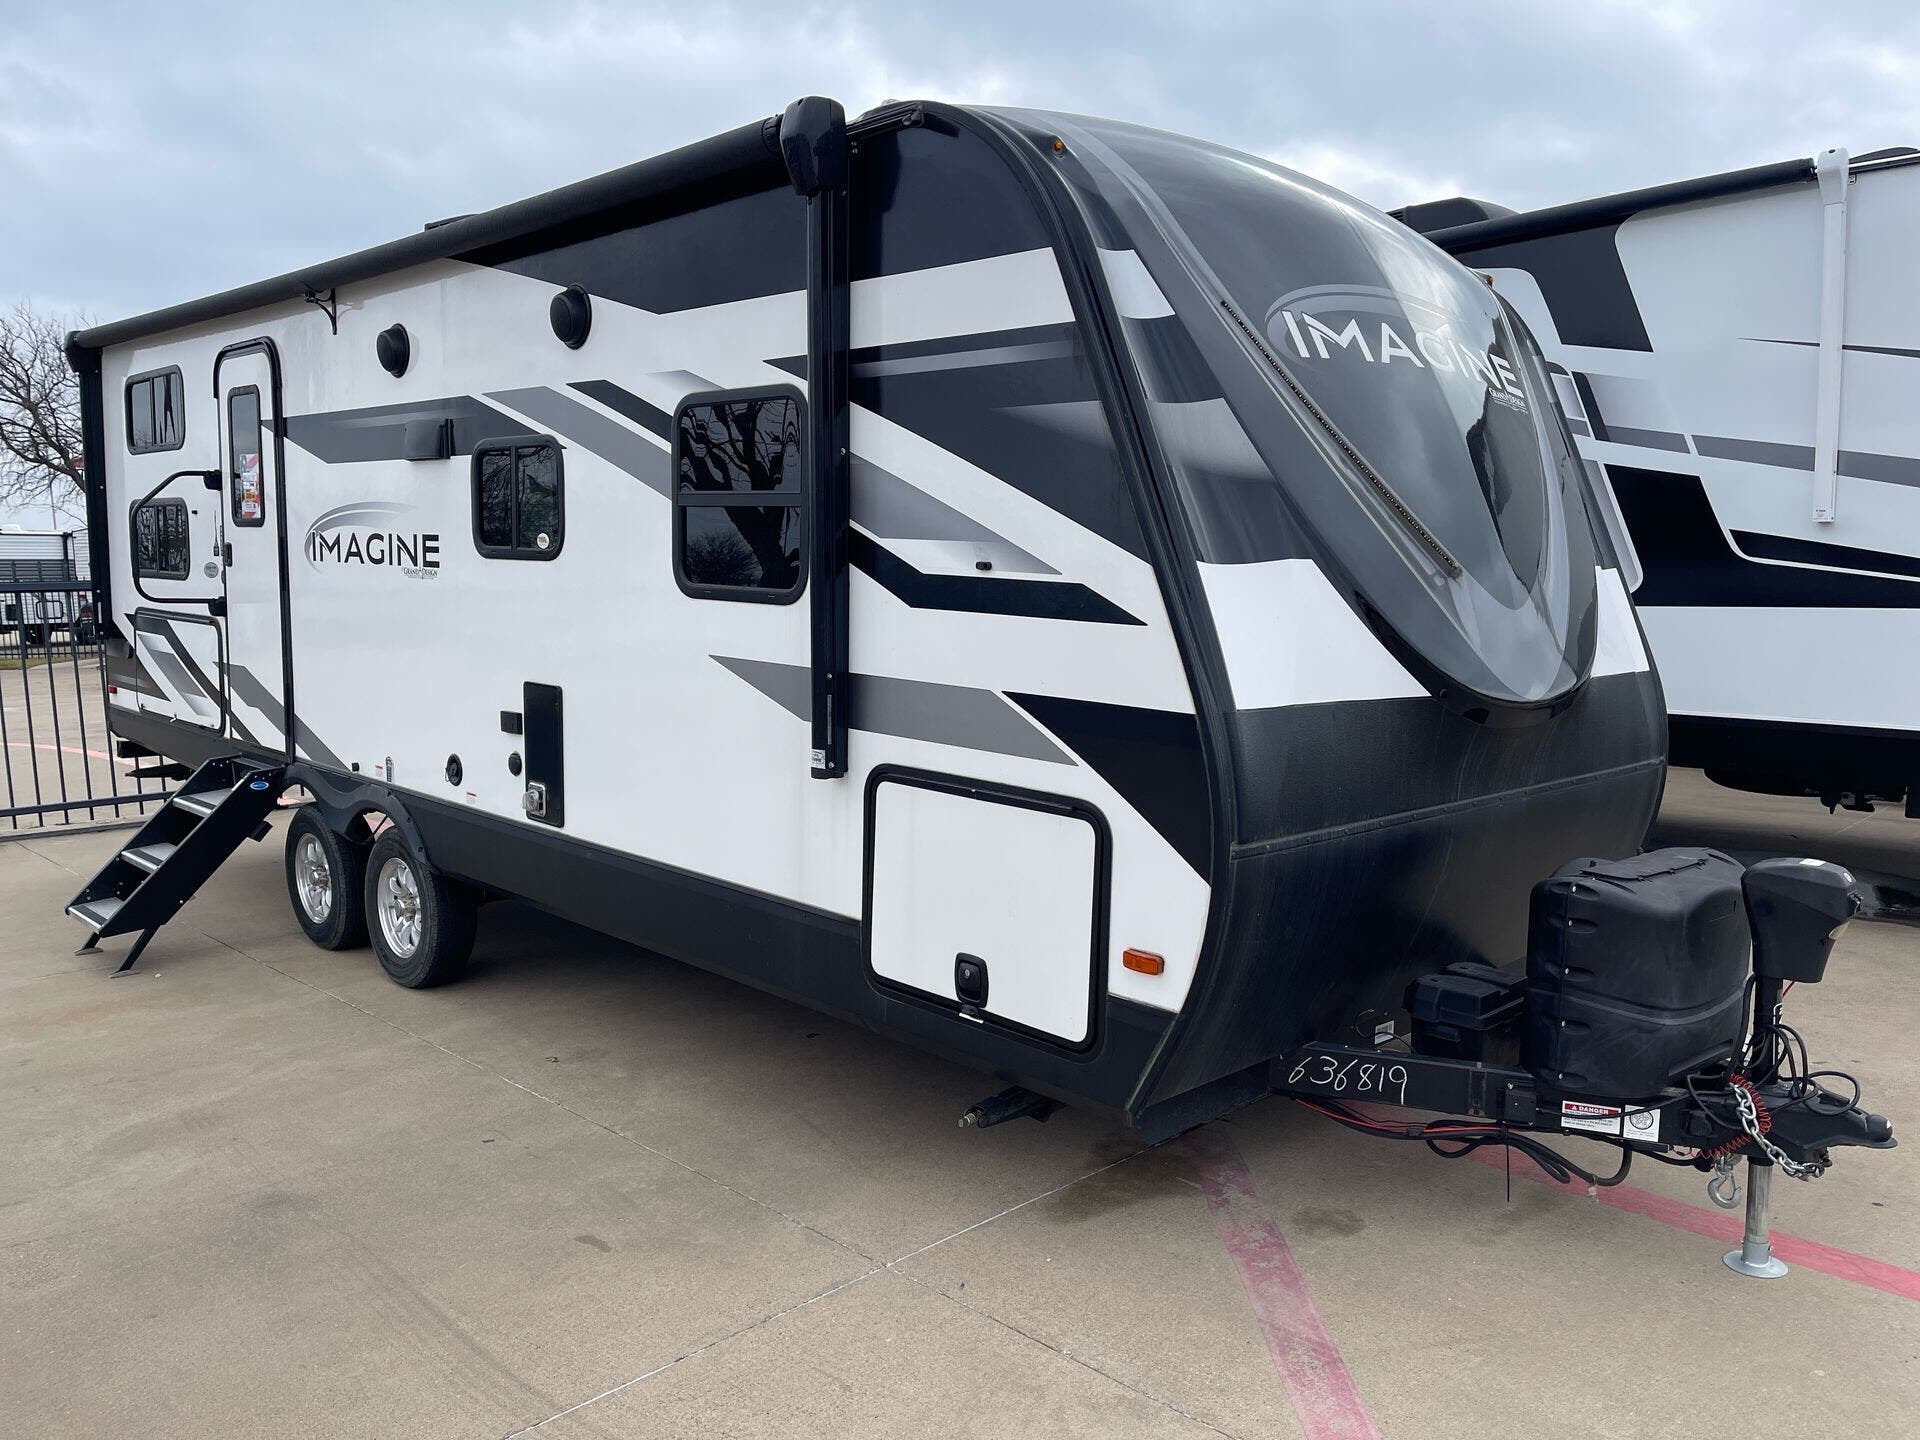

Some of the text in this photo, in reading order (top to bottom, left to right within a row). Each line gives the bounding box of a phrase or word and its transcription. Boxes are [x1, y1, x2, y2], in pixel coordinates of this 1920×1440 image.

[1281, 310, 1525, 399] IMAGINE
[311, 531, 440, 569] IMAGINE
[1288, 1055, 1408, 1105] 636819
[1578, 1106, 1609, 1115] DANGER
